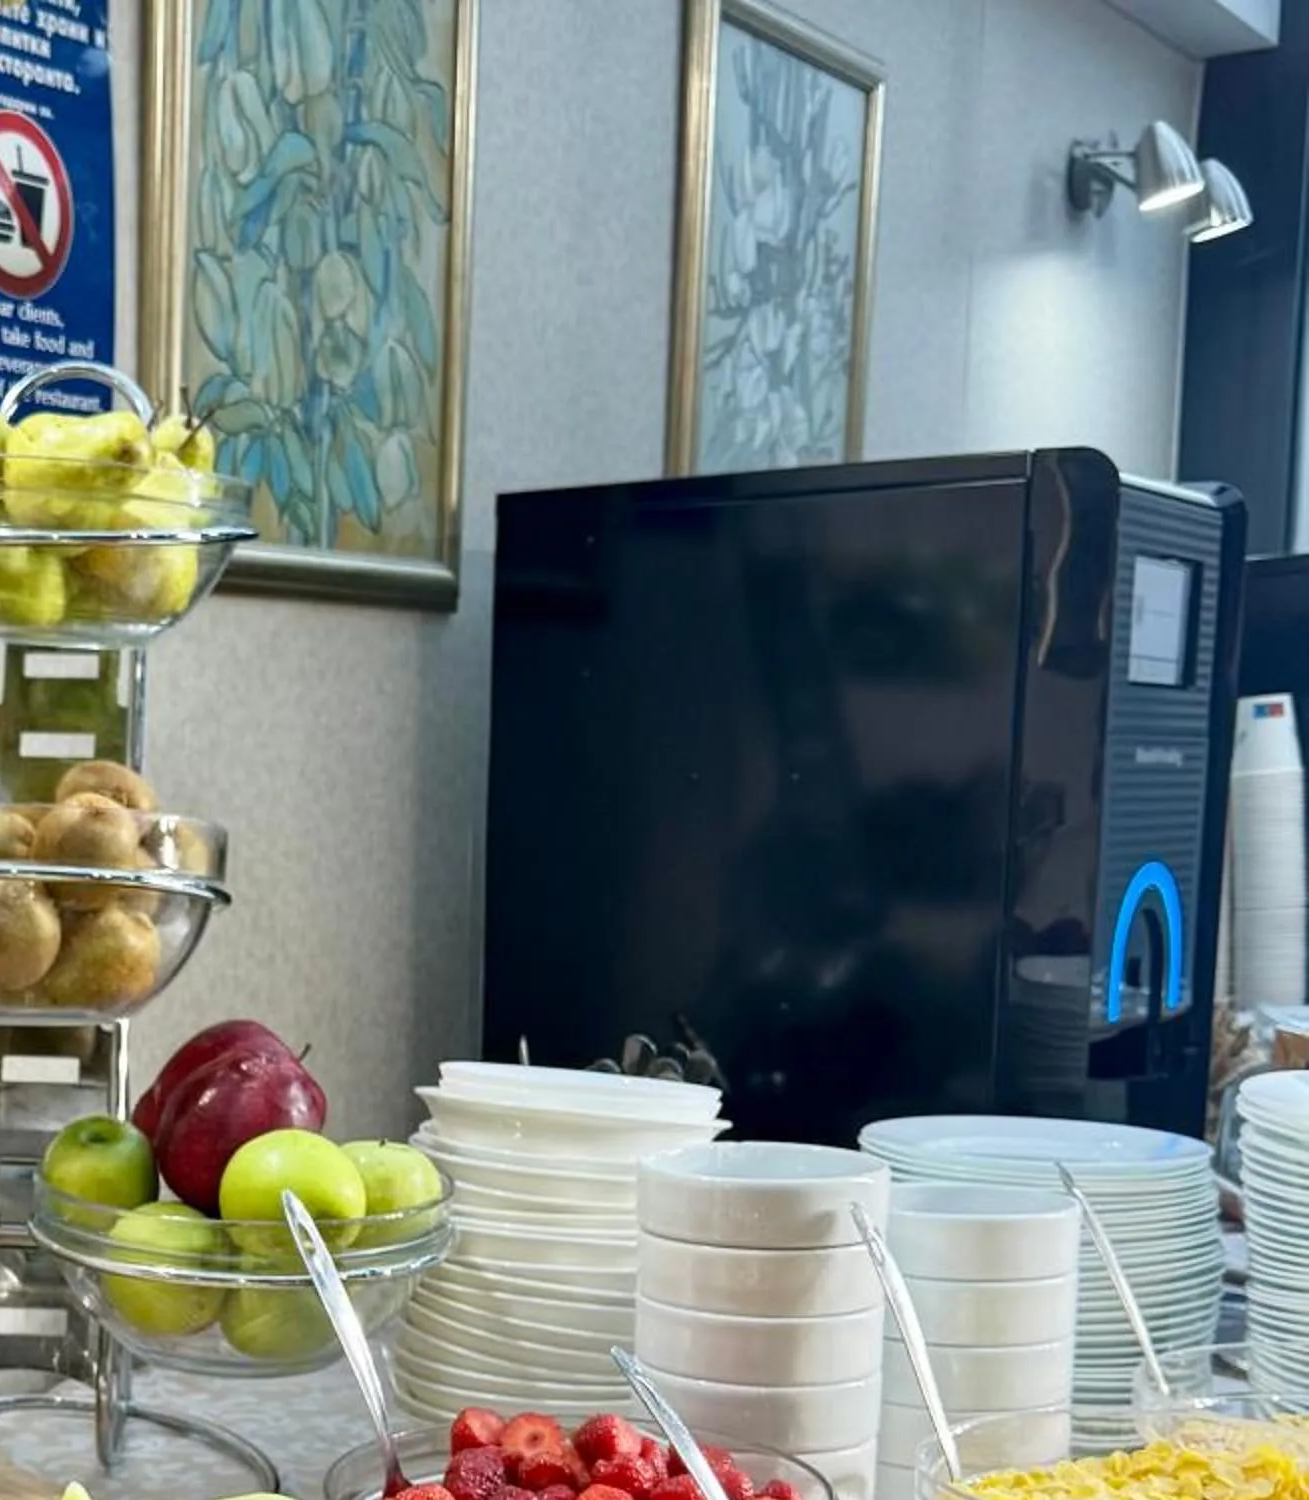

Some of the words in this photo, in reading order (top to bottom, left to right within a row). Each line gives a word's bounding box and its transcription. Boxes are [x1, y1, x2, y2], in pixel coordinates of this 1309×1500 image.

[0, 325, 31, 350] take
[33, 330, 66, 356] food
[67, 339, 95, 361] and
